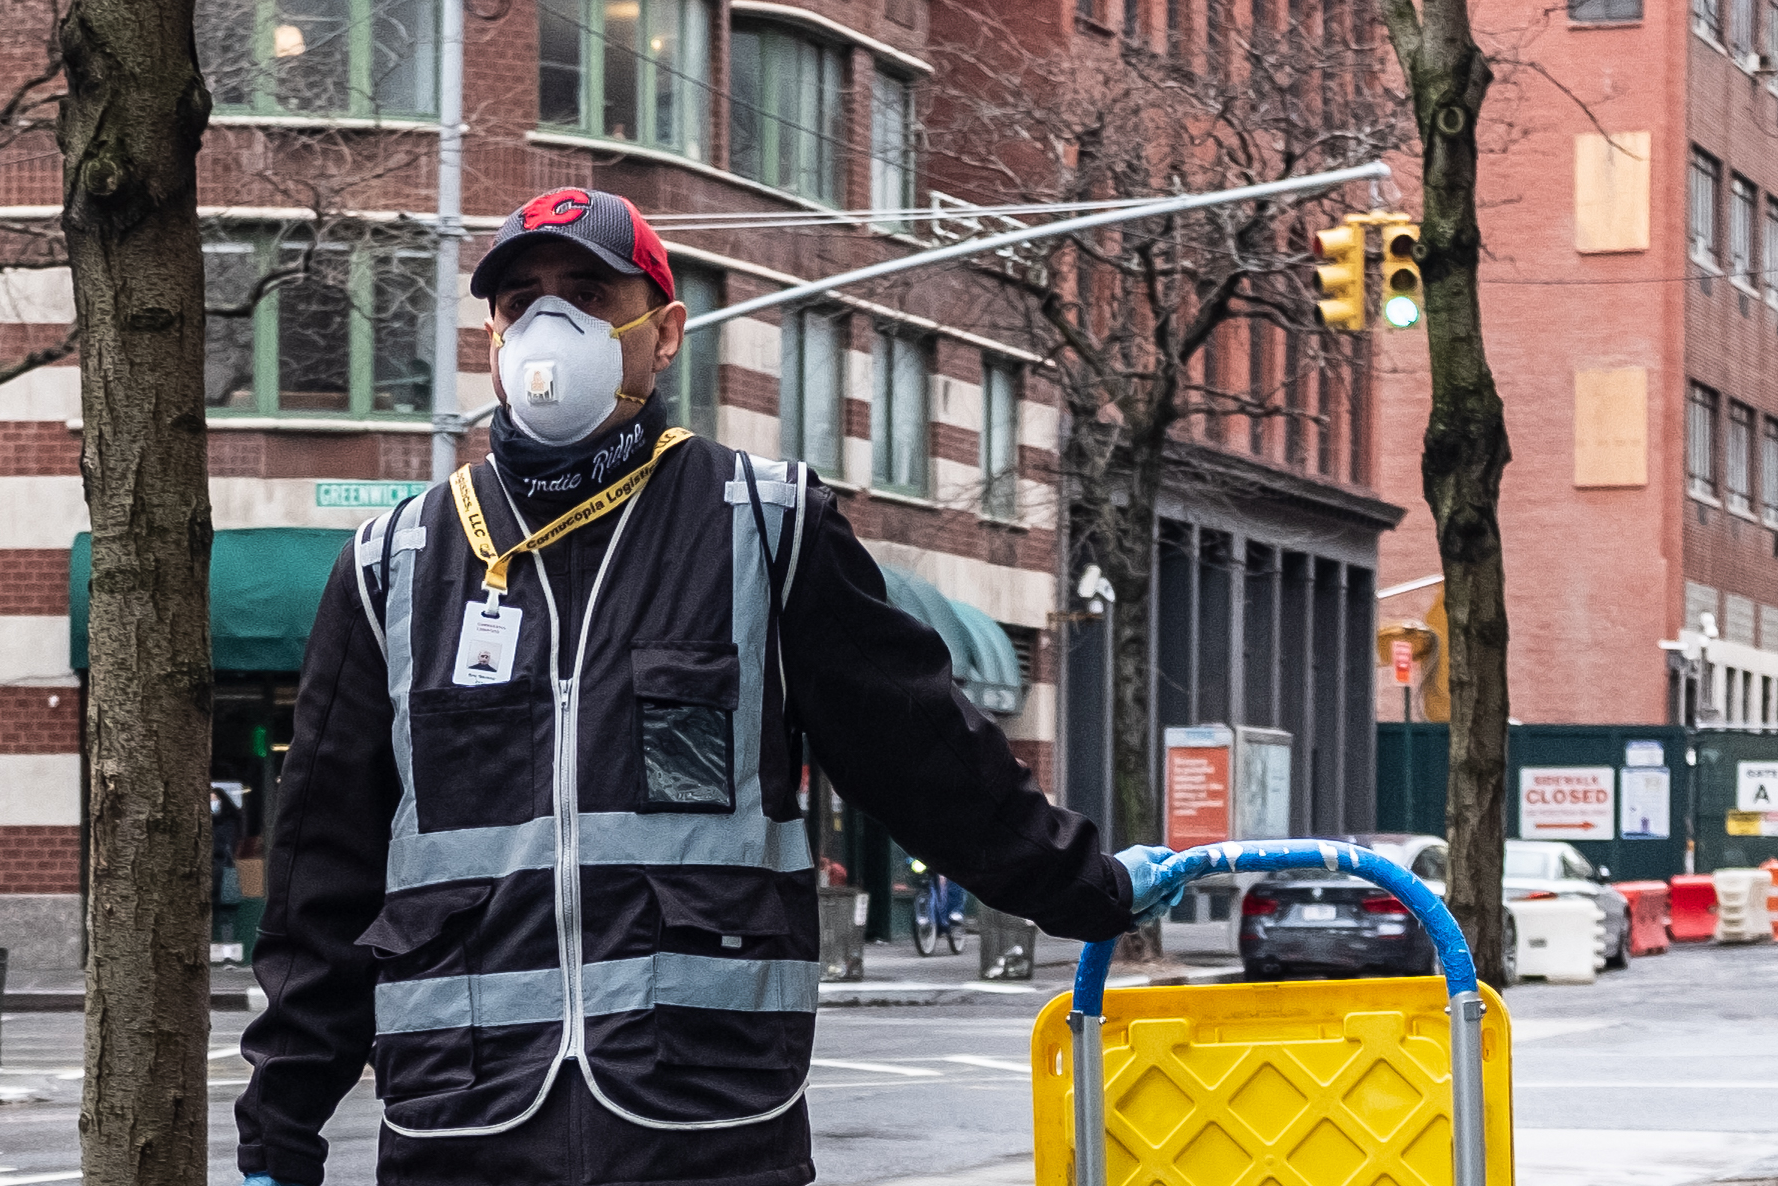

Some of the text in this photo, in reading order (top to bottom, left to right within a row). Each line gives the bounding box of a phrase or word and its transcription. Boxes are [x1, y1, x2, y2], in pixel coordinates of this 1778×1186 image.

[591, 423, 645, 484] Ridge
[468, 513, 486, 538] LLC
[525, 498, 606, 550] Cornucopia
[1525, 789, 1609, 805] CLOSED
[1752, 783, 1771, 804] A
